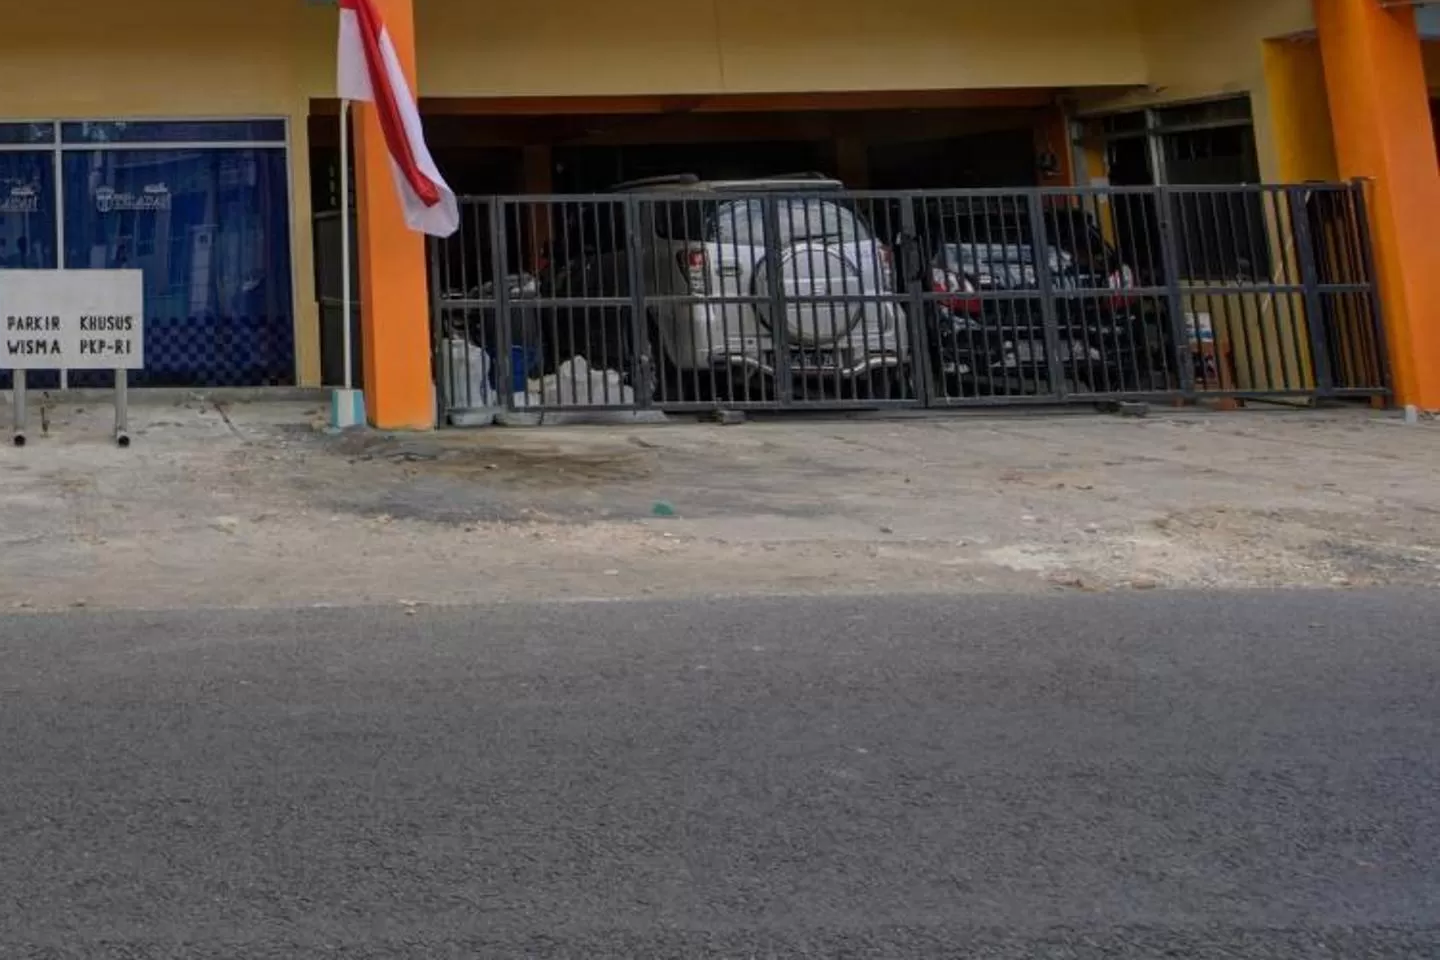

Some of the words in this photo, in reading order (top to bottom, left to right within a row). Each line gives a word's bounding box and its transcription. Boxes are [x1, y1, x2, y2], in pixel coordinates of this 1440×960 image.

[7, 315, 60, 331] PARKIR
[80, 315, 133, 331] KHUSUS
[7, 339, 61, 354] WISMA
[80, 339, 131, 354] PKP-RI
